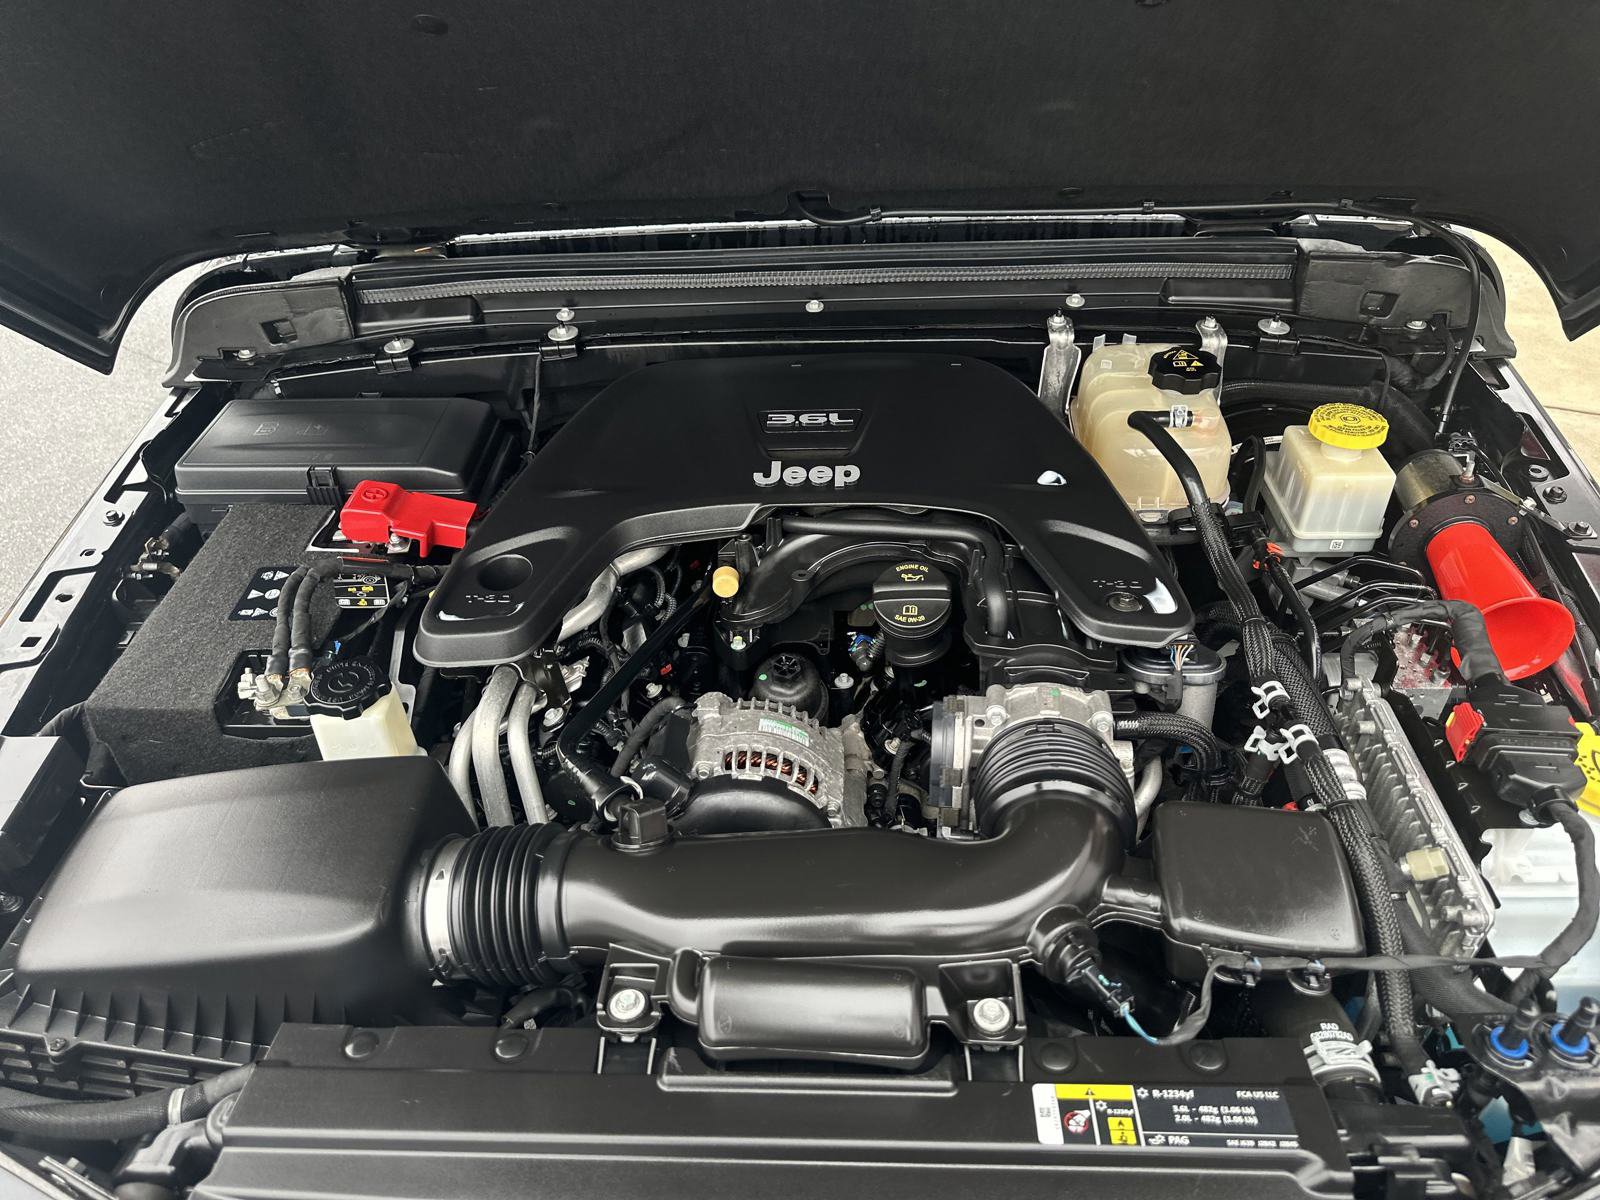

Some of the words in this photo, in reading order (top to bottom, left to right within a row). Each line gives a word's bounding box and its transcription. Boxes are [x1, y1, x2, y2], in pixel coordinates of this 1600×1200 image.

[766, 413, 853, 427] 3.6L
[753, 461, 861, 489] Jeep
[895, 564, 919, 572] ENGINE
[895, 614, 907, 623] SAE
[1320, 1022, 1339, 1031] RAD
[1152, 1089, 1195, 1101] R-1234yf
[1236, 1090, 1253, 1099] FCA
[1265, 1091, 1280, 1099] LLC
[1168, 1135, 1190, 1146] PAG
